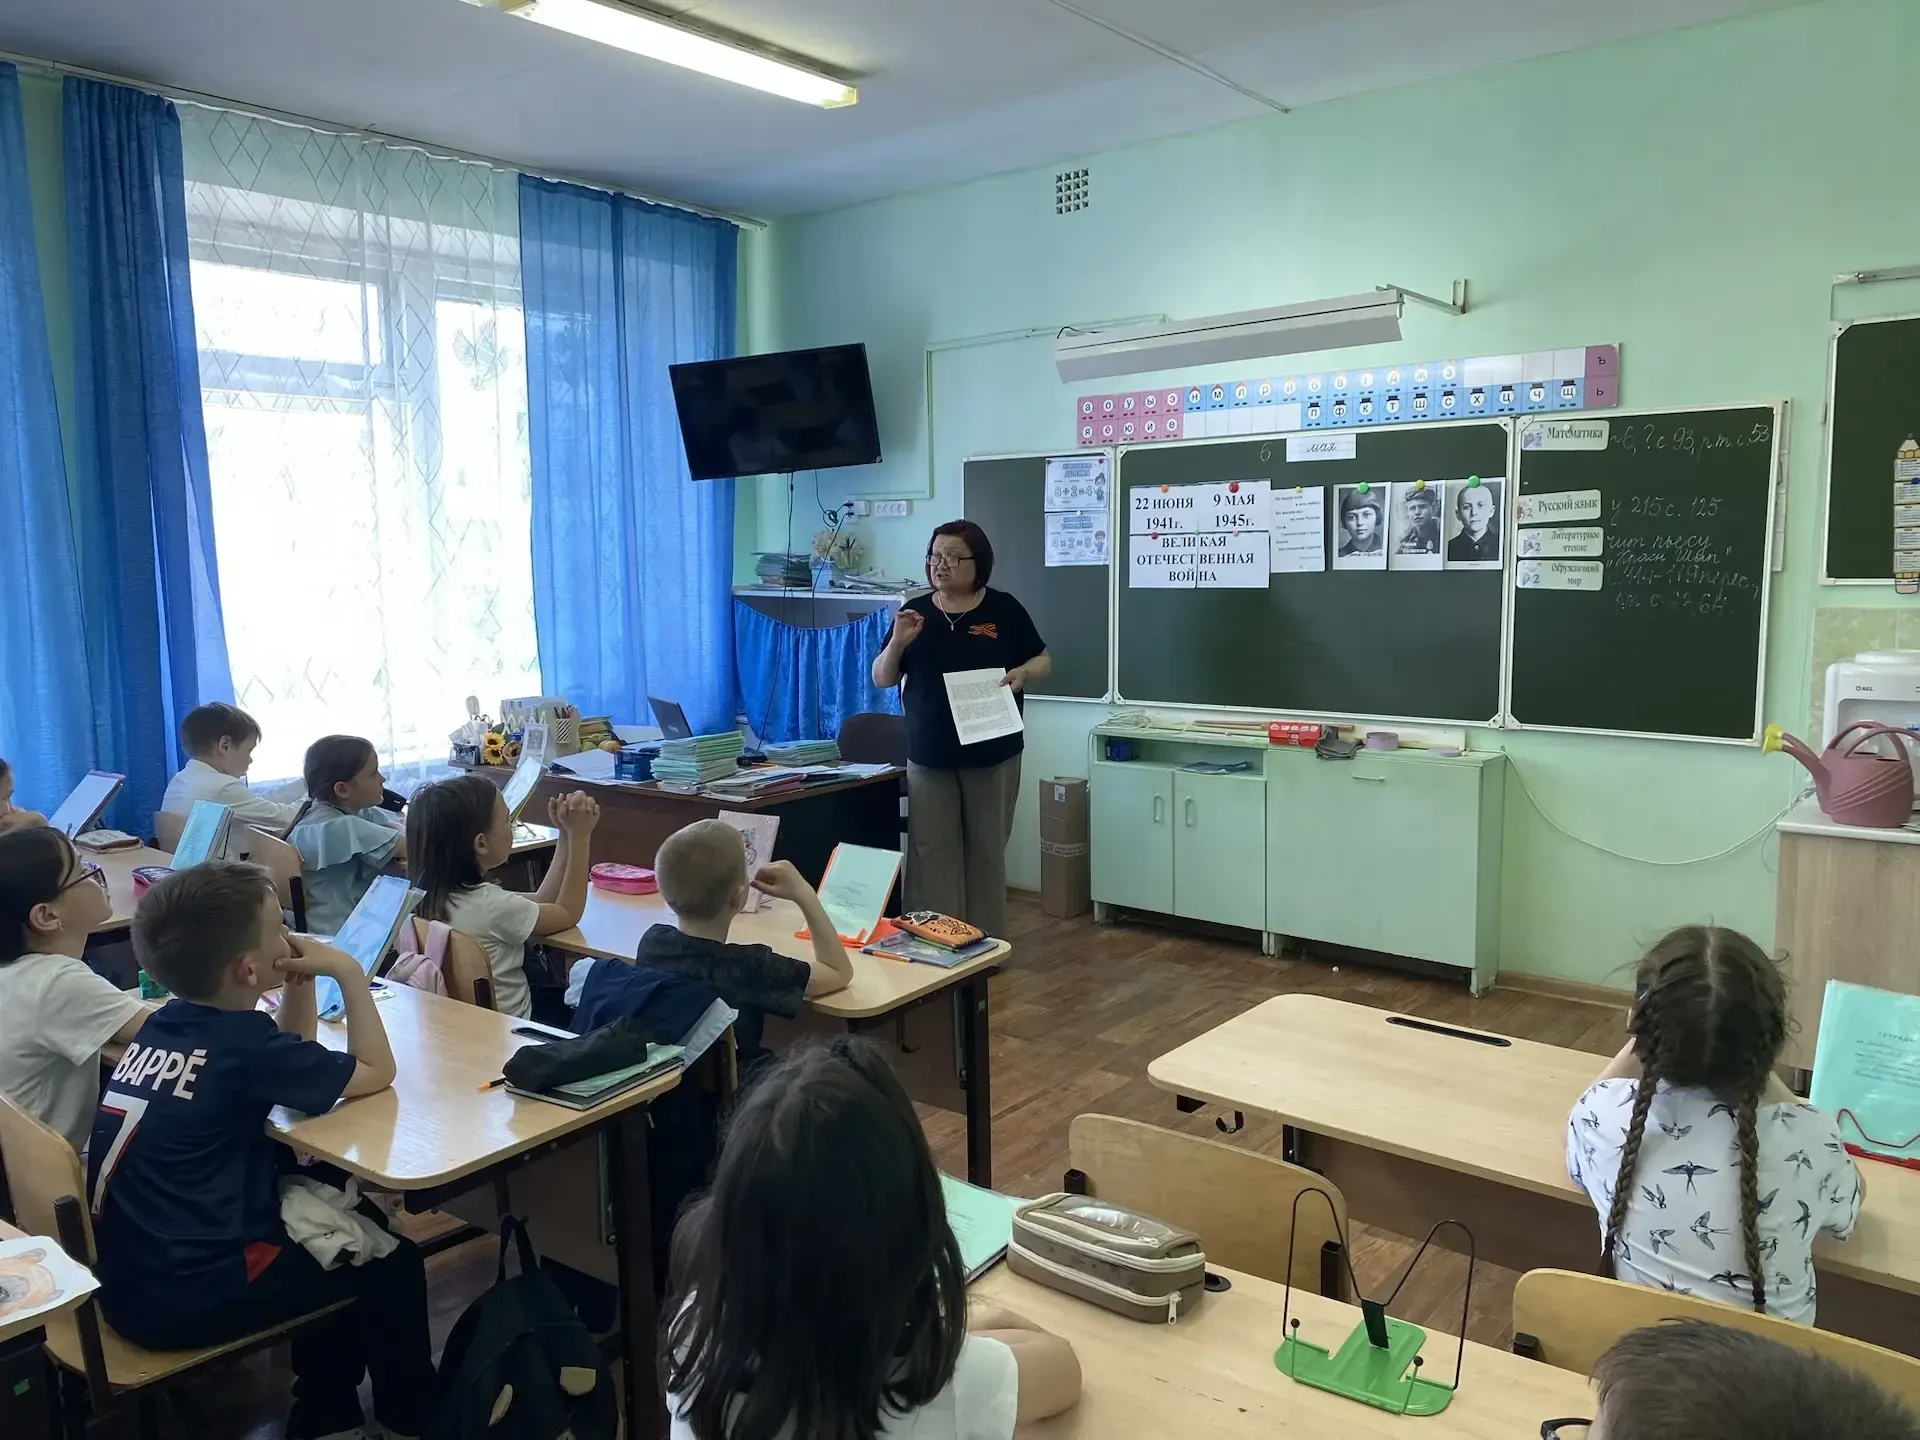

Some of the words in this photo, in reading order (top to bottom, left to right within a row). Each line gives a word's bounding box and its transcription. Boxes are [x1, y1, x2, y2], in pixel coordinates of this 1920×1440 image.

[1547, 426, 1603, 439] Математика
[1260, 441, 1275, 462] 6
[1306, 442, 1336, 453] мая
[1135, 498, 1149, 510] 22
[1153, 497, 1193, 510] ИЮНЯ
[1213, 494, 1221, 506] 9
[1225, 494, 1255, 506] МАЯ
[1538, 498, 1573, 514] Русский
[1574, 499, 1598, 509] язык
[1146, 517, 1183, 530] 1941г.
[1215, 514, 1255, 527] 1945г.
[1162, 536, 1227, 548] ВЕЛИКАЯ
[1551, 530, 1600, 542] Литературное
[1562, 544, 1587, 552] чтение
[1136, 553, 1254, 565] ОТЕЧЕСТВЕННАЯ
[1551, 562, 1600, 574] Окружающий
[1169, 568, 1217, 581] ВОЙНА
[1567, 578, 1582, 587] мир
[91, 1090, 149, 1215] 7
